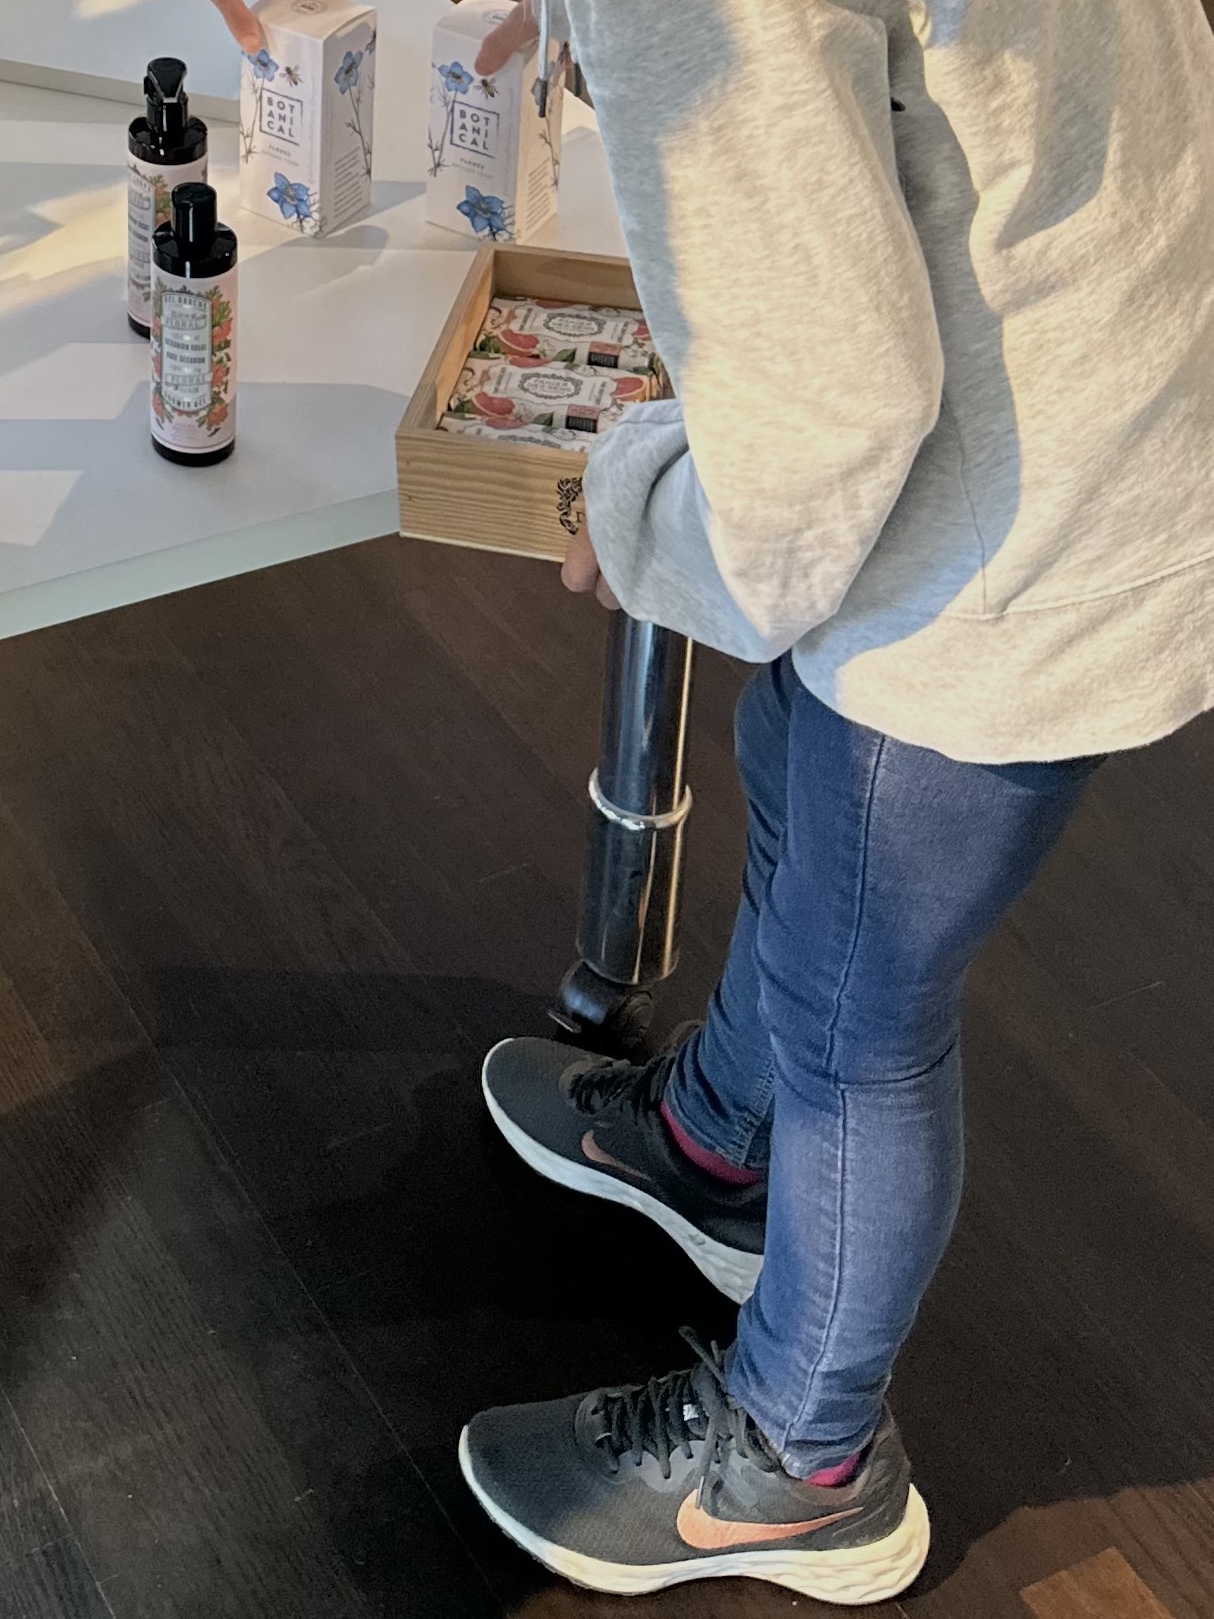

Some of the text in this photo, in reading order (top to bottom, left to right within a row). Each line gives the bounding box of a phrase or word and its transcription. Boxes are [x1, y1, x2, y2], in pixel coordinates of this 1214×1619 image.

[267, 96, 295, 114] BOT
[267, 109, 294, 127] ANI
[459, 109, 490, 127] BOT
[266, 120, 295, 138] CAL
[459, 122, 489, 139] ANI
[458, 132, 489, 151] CAL
